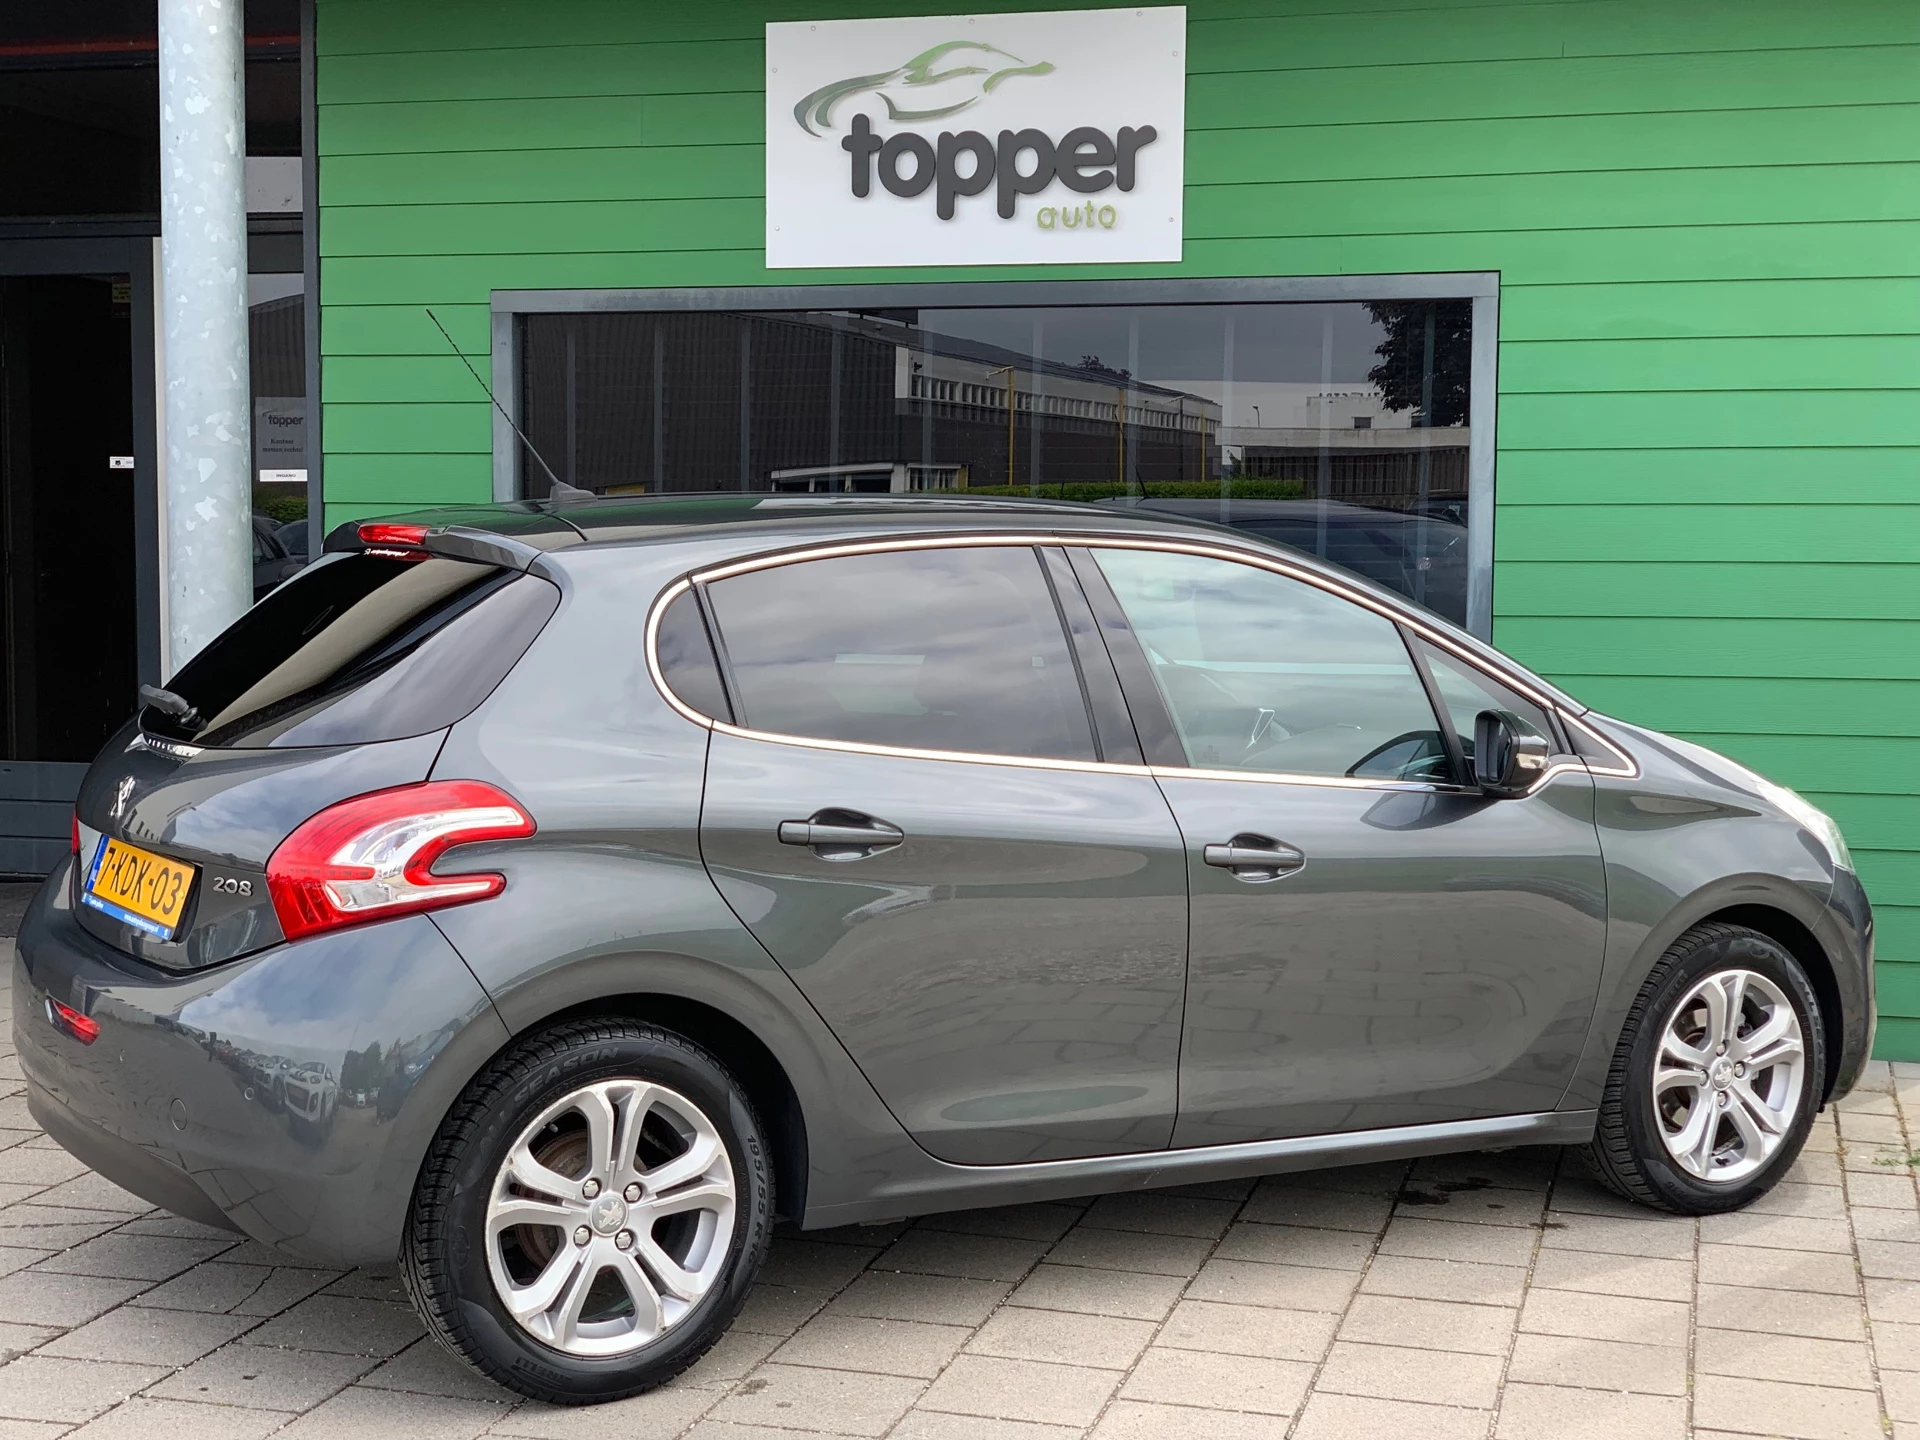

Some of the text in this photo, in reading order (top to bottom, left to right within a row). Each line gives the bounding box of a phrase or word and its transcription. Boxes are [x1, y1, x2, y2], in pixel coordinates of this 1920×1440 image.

[841, 112, 1158, 221] topper
[1036, 200, 1118, 230] auto
[268, 414, 303, 427] topper
[98, 847, 183, 915] 7-KDK-03
[212, 876, 252, 897] 208
[514, 1047, 619, 1103] SEASON
[747, 1134, 767, 1217] 195/55
